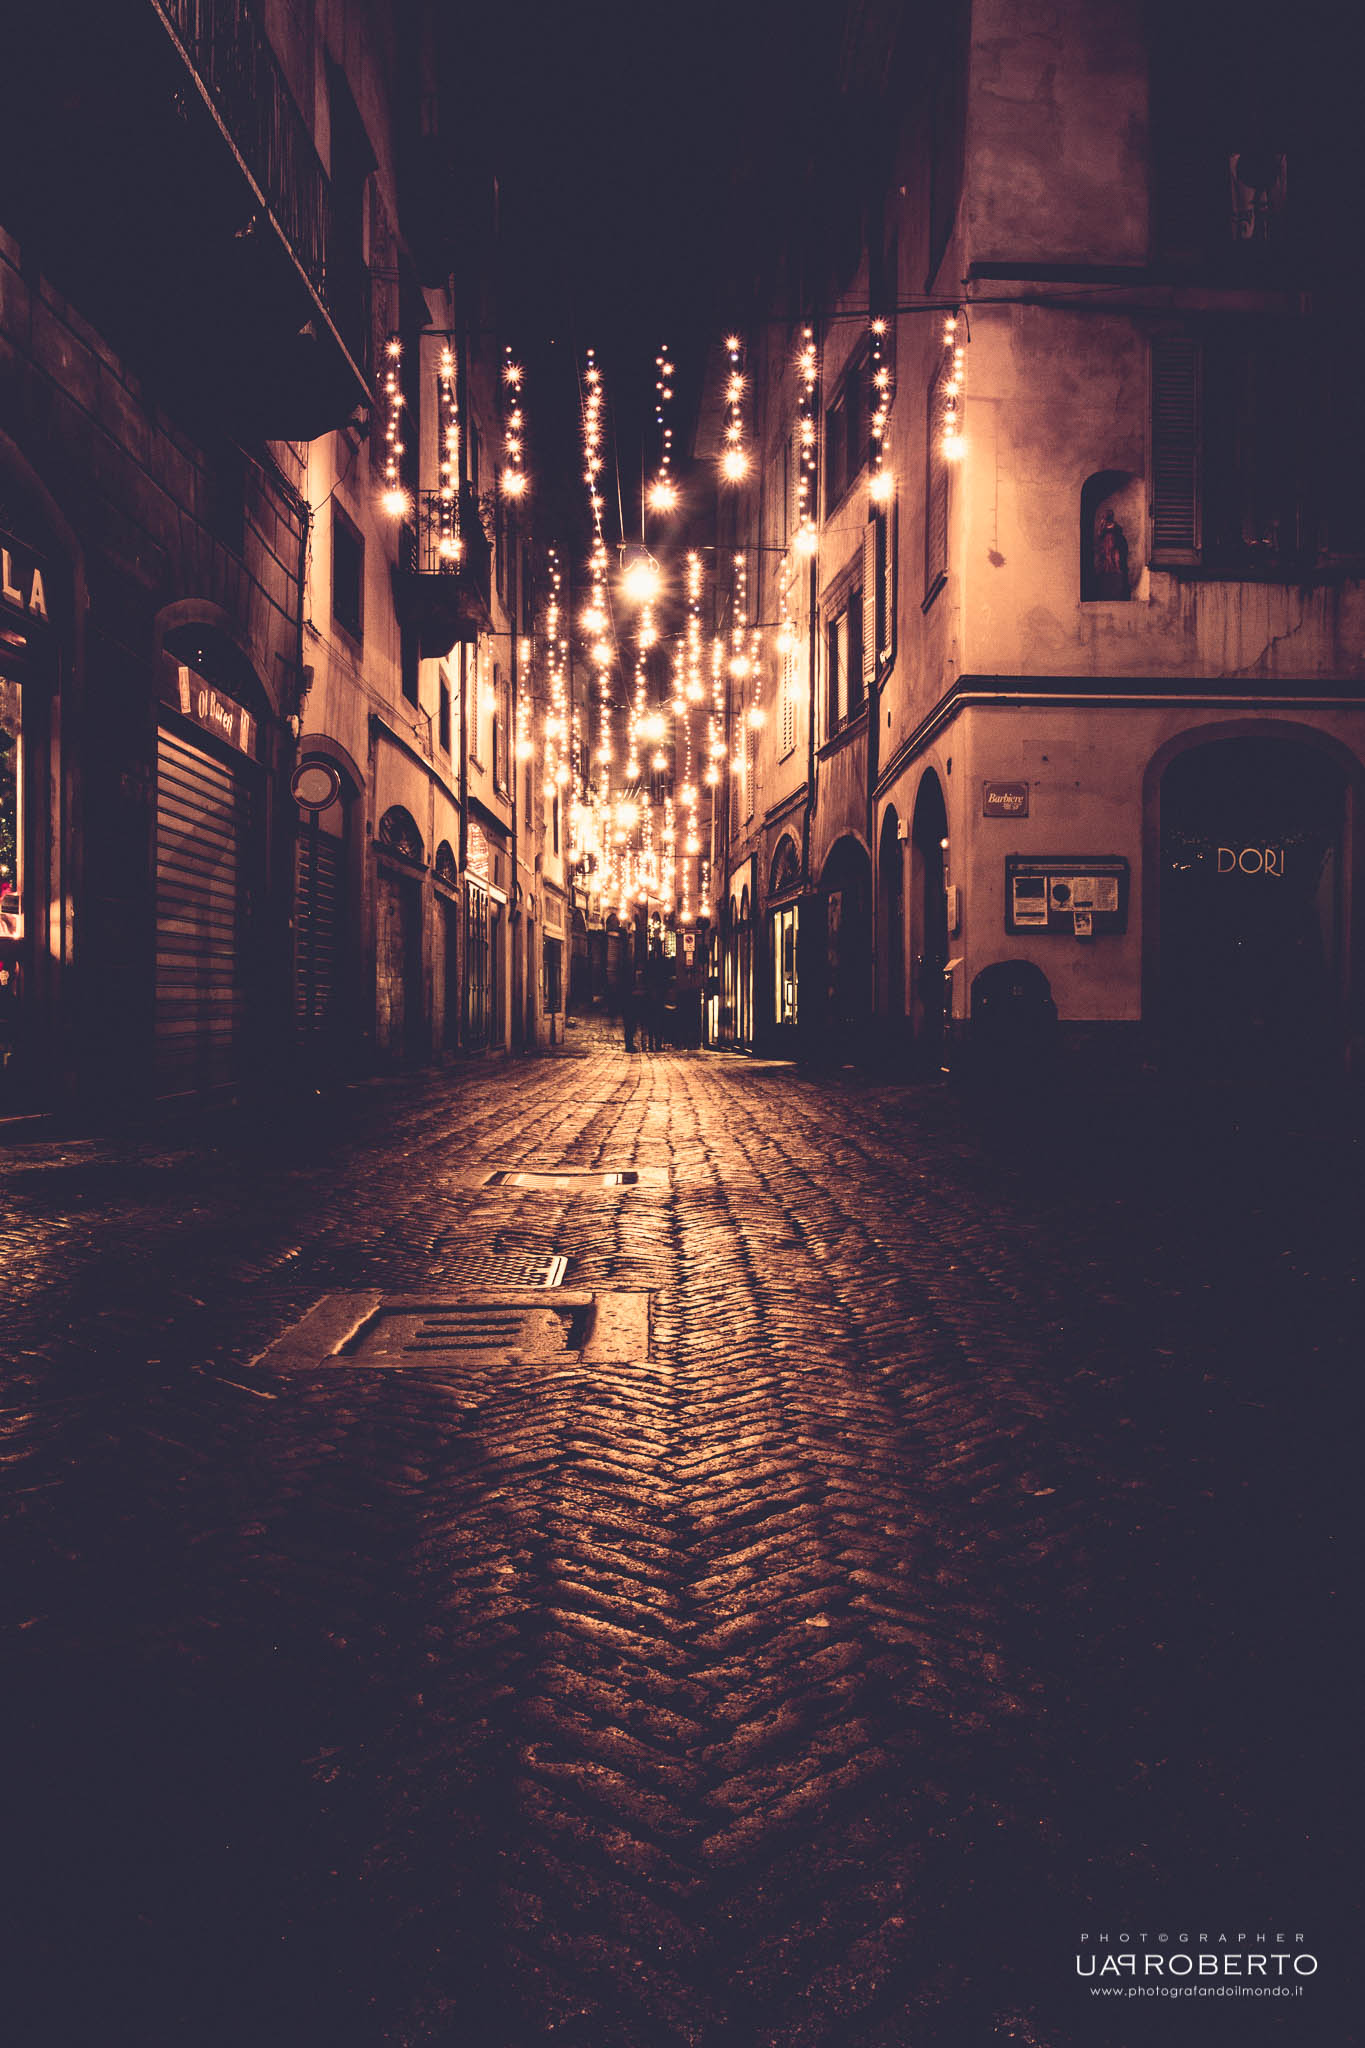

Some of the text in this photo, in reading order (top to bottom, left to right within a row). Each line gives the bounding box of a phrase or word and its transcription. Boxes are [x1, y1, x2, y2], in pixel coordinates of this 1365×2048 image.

[1, 547, 47, 617] LA
[988, 792, 1025, 804] Barbiere
[1217, 847, 1285, 877] DORI
